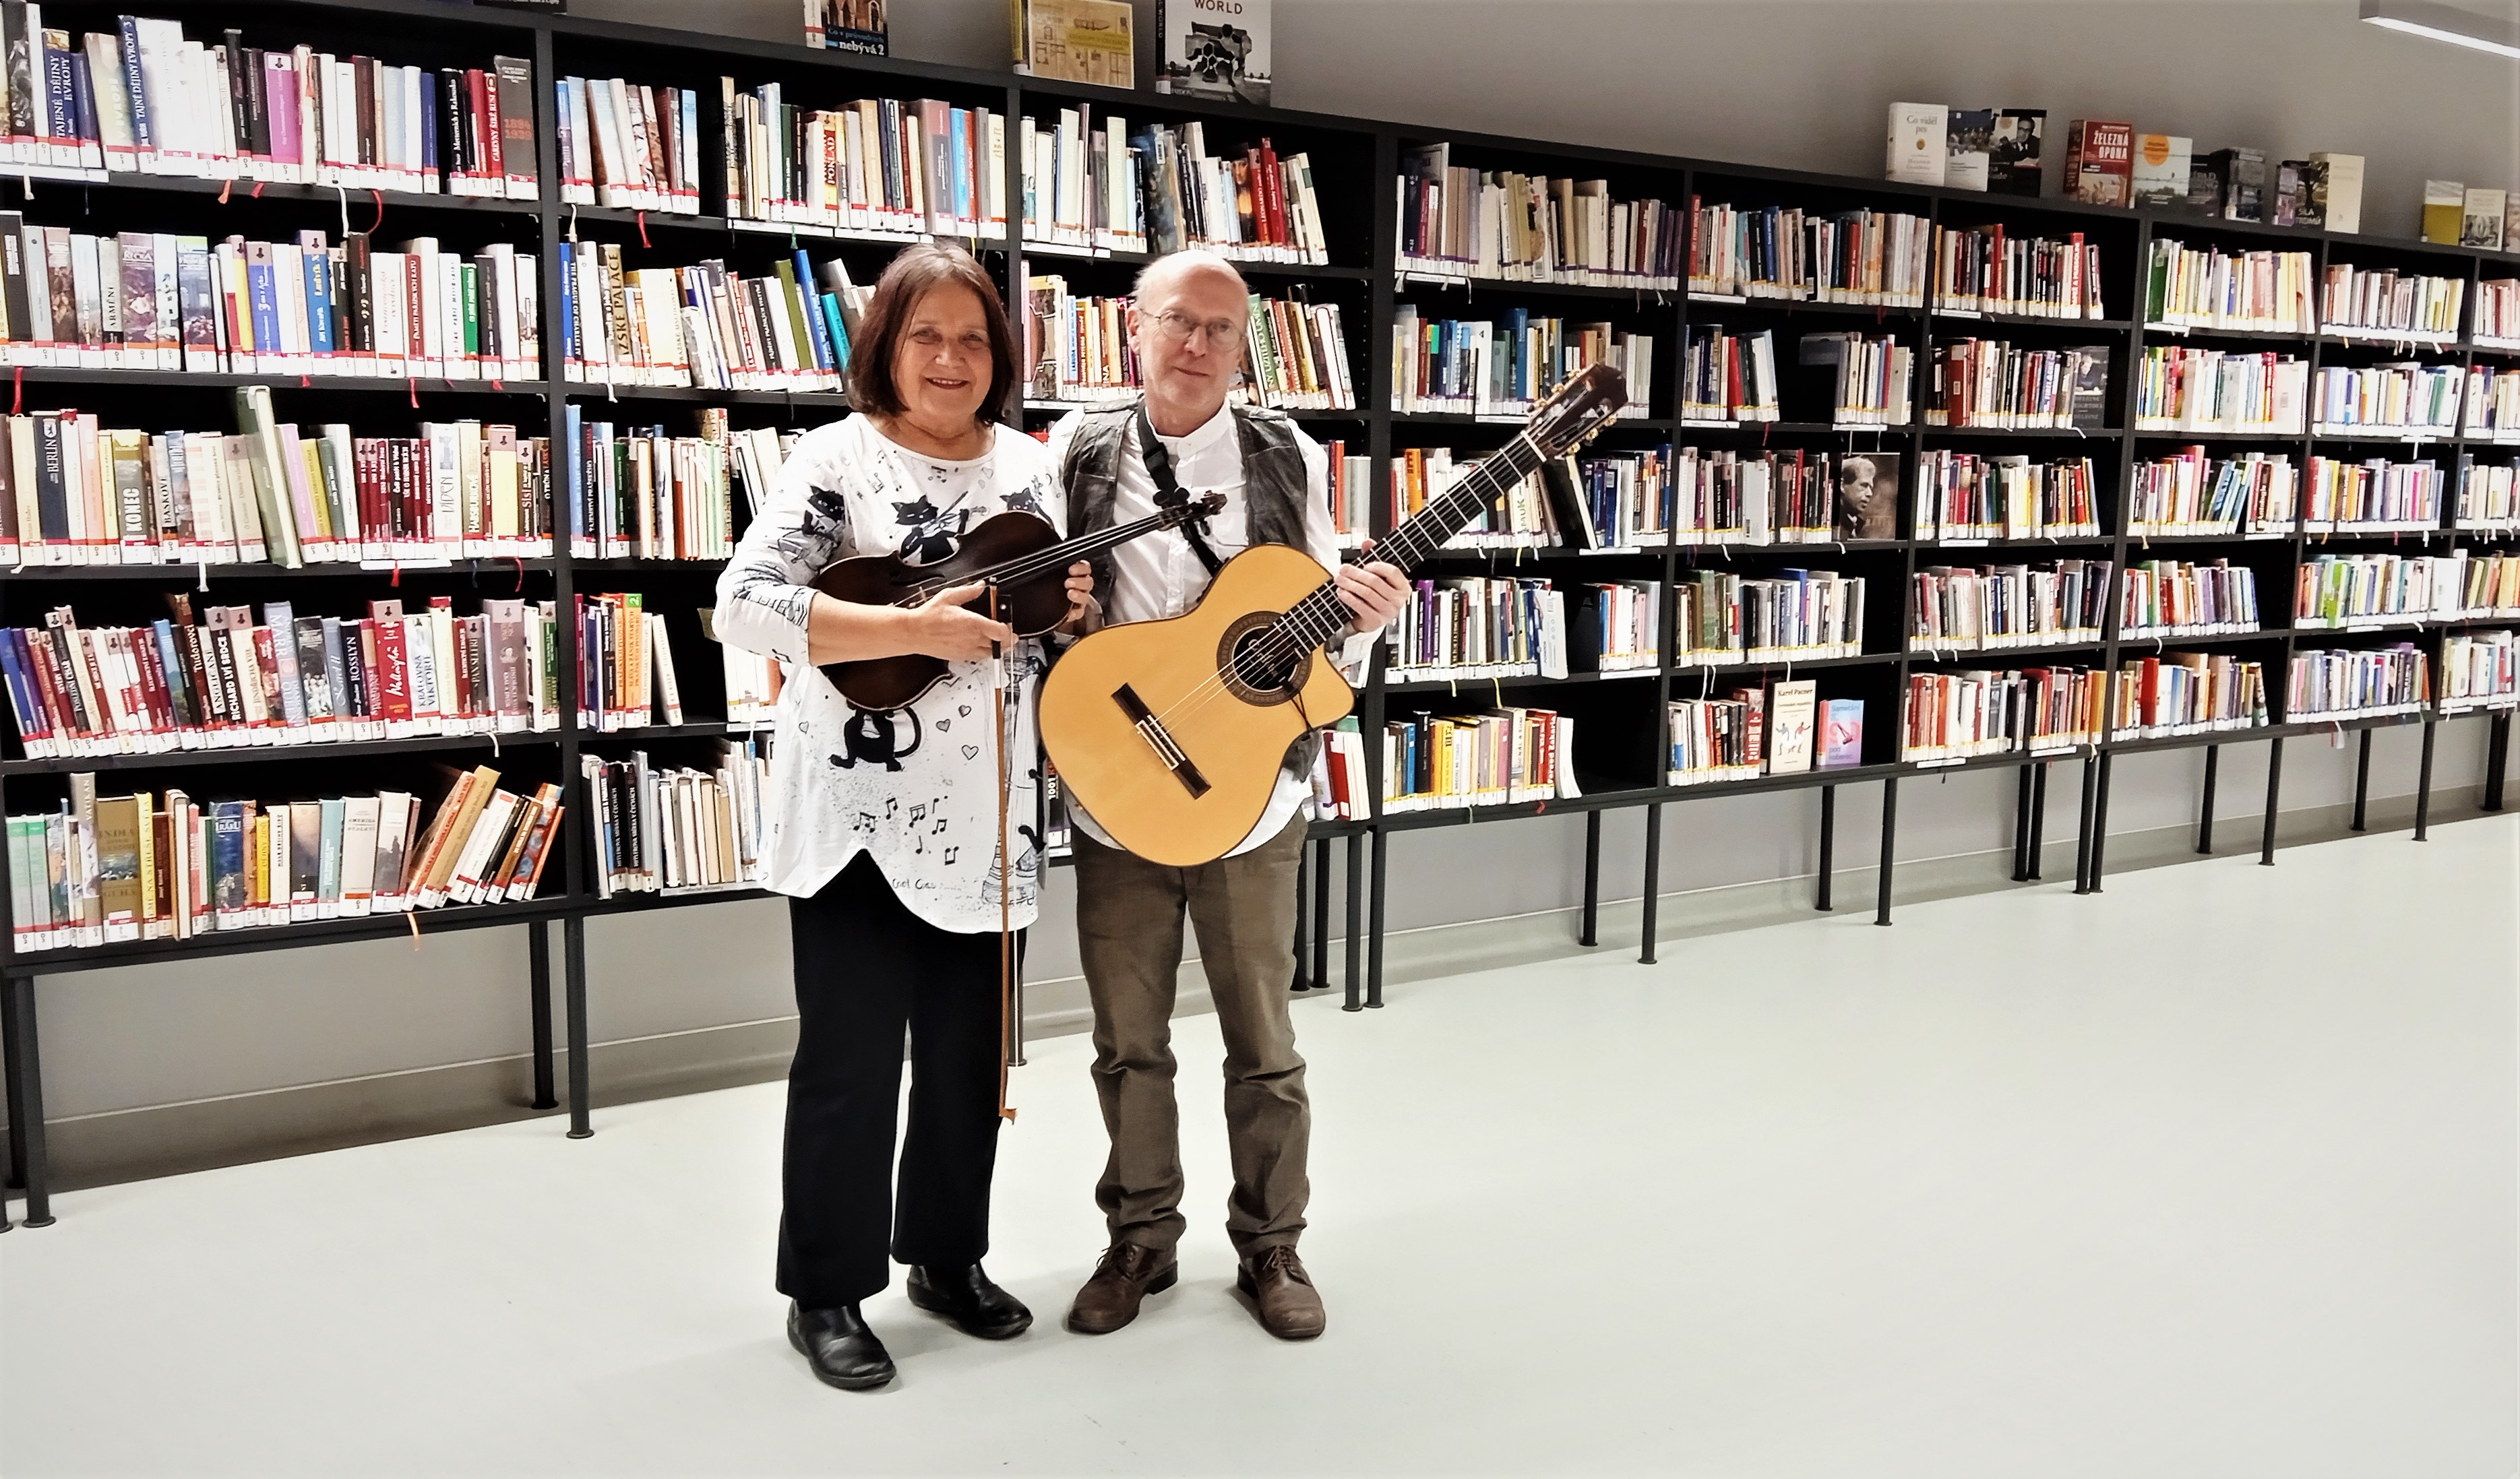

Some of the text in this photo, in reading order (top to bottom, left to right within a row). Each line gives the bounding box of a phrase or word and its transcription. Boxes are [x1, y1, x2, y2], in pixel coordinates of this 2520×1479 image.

[1194, 0, 1242, 15] WORLD
[123, 32, 139, 63] EVROPY
[839, 40, 884, 55] nebývá 2
[49, 55, 62, 95] DĚJINY
[61, 57, 73, 101] EVROPY
[129, 64, 143, 93] DĚJINY
[131, 94, 146, 119] TAJNÉ
[449, 79, 459, 109] Rakousko
[451, 117, 461, 151] Metternich
[1906, 115, 1938, 125] Co viděl
[490, 131, 501, 162] CAREVNY
[2093, 130, 2128, 146] ŽELEZNÁ
[2099, 146, 2127, 160] OPONA
[826, 136, 836, 184] POKLAD
[1258, 187, 1267, 222] LEONARDO
[312, 263, 323, 296] Ludvík
[572, 304, 578, 316] OF
[575, 347, 581, 355] IV
[45, 439, 59, 472] BERLÍN
[123, 486, 142, 532] KONEC
[185, 624, 203, 672] Tudorovci
[270, 614, 287, 658] MARR
[346, 636, 361, 682] ROSSLYN
[62, 660, 83, 712] POSLEDNÍ CÍSAŘ
[217, 636, 241, 720] RICHARD LVÍ SRDCE
[1777, 689, 1793, 697] Karel
[82, 778, 93, 821] VATIKÁN
[146, 878, 154, 892] NA
